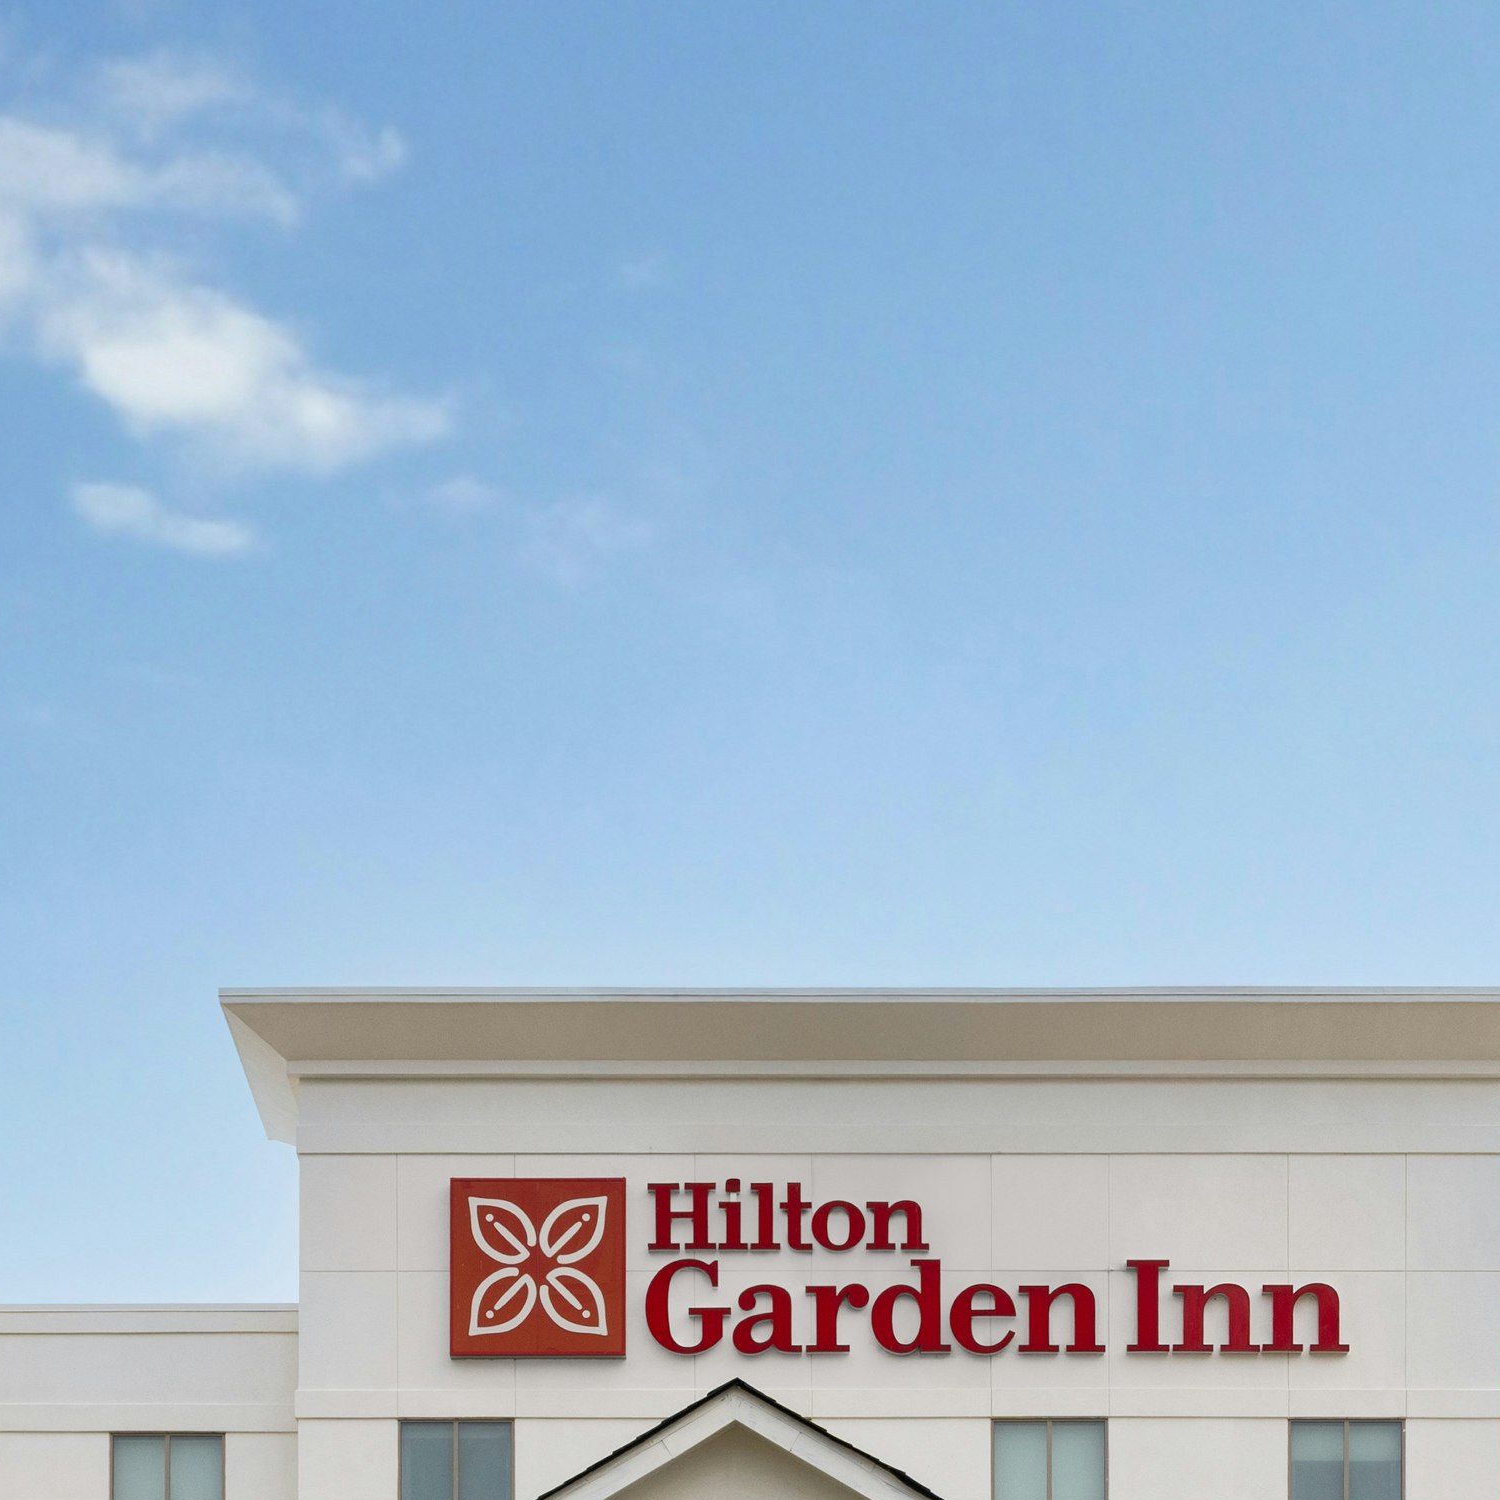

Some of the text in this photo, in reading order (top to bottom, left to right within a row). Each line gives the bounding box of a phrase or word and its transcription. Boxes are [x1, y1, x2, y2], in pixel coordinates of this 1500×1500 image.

[647, 1178, 930, 1252] Hilton
[644, 1258, 1350, 1355] Garden Inn
